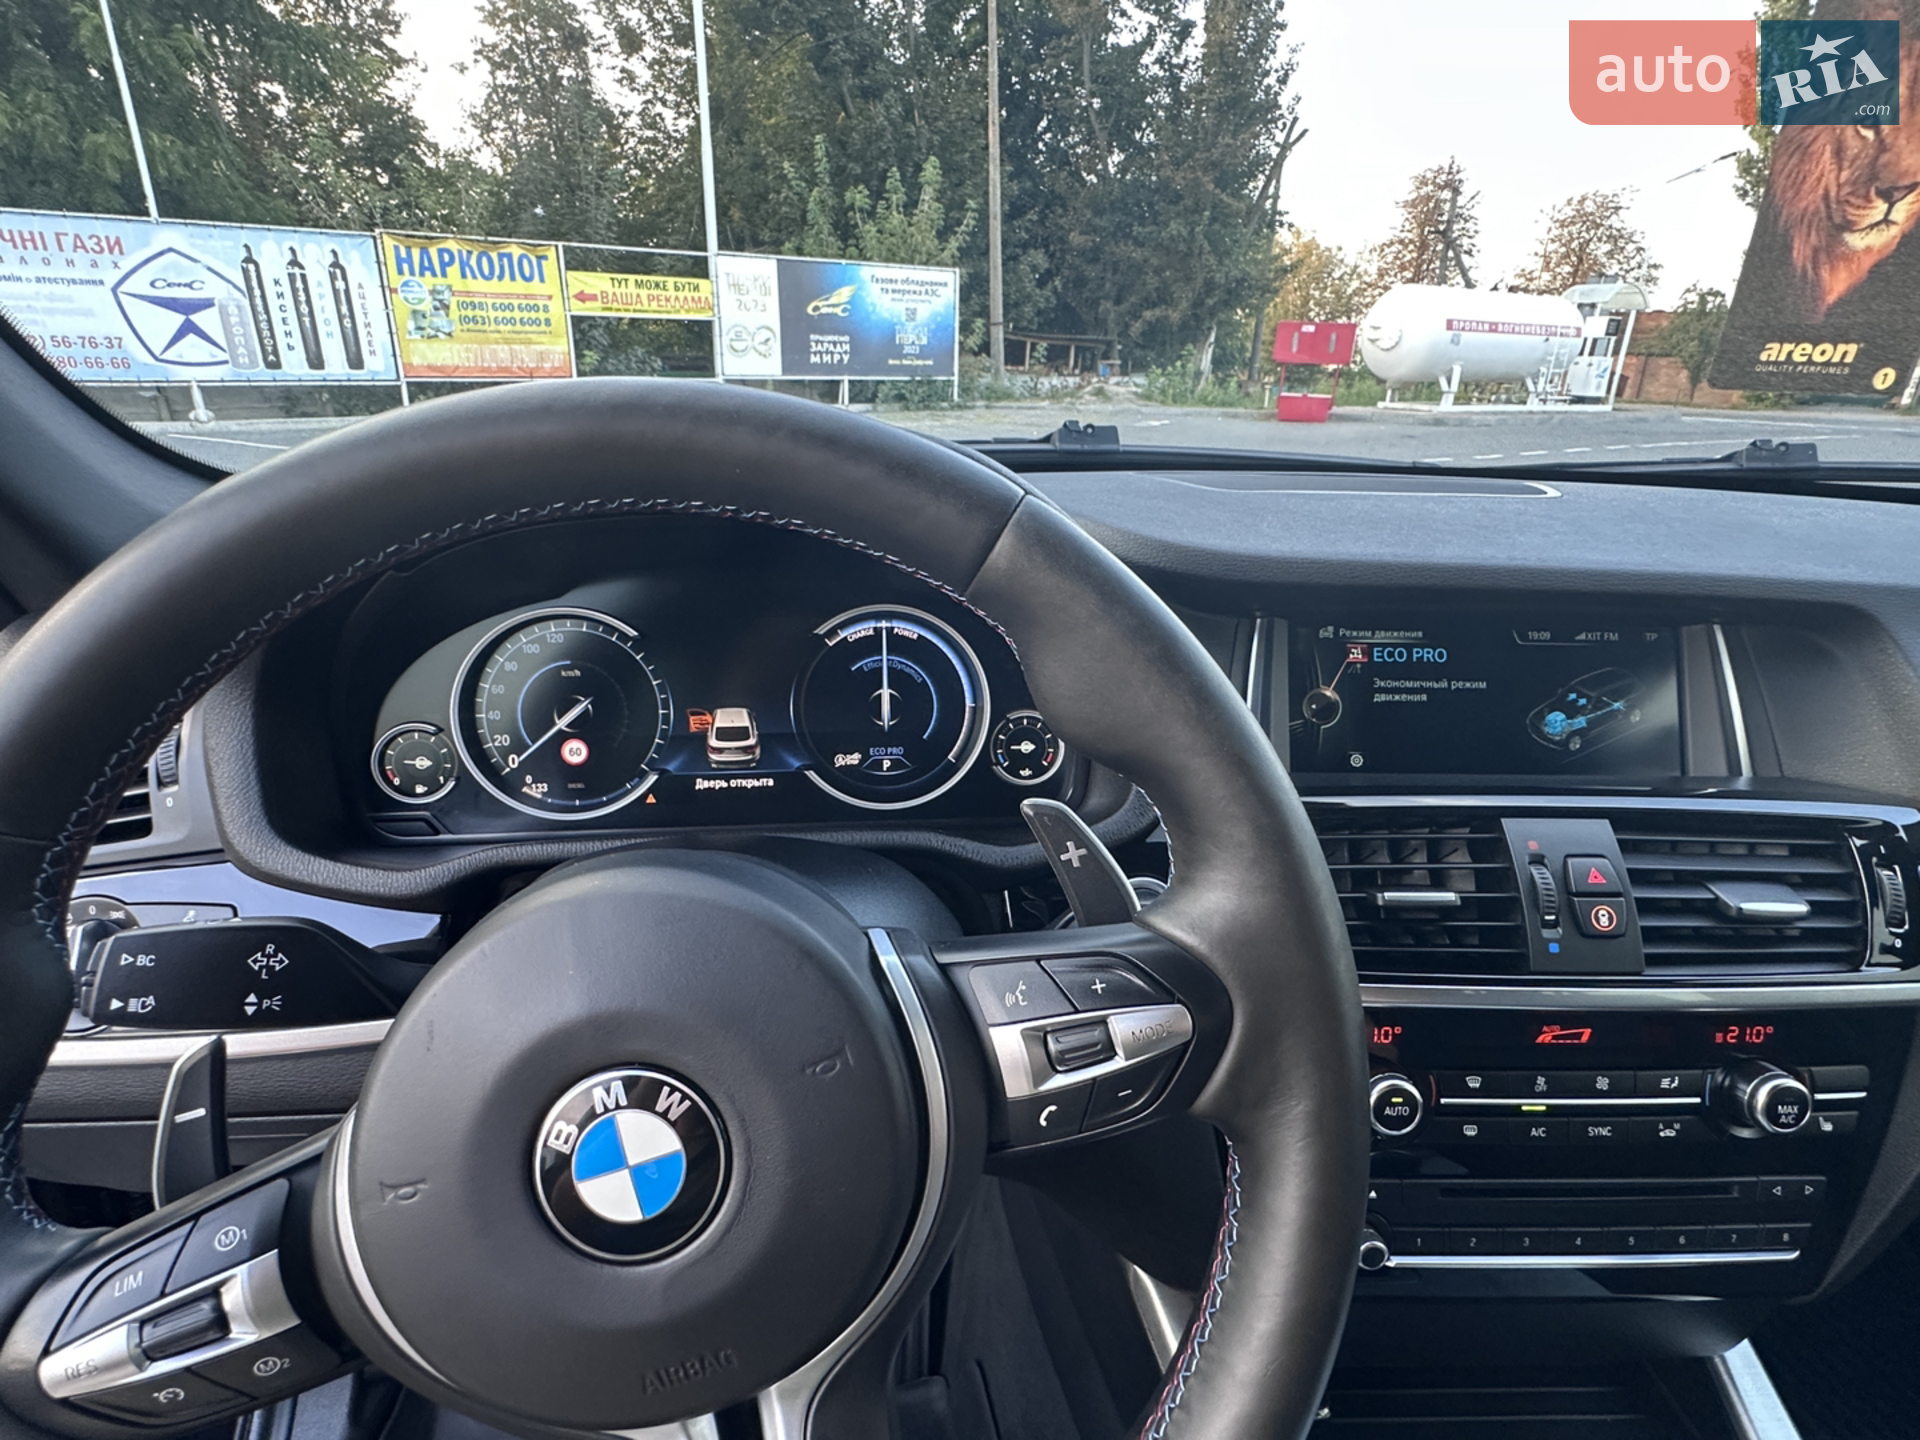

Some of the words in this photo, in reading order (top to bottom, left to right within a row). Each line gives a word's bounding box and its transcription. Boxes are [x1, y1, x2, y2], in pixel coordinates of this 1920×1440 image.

[54, 232, 125, 256] ГАЗИ
[394, 244, 549, 284] НАРКОЛОГ
[609, 277, 630, 290] ТУТ
[635, 278, 669, 292] МОЖЕ
[673, 281, 700, 293] БУТИ
[457, 300, 489, 313] (098)
[491, 302, 515, 312] 600
[517, 303, 540, 313] 600
[542, 304, 550, 313] 8
[600, 291, 644, 307] ВАША
[647, 294, 714, 312] РЕКЛАМА
[273, 278, 295, 352] КИСЕНЬ
[459, 314, 491, 327] (063)
[494, 316, 517, 326] 600
[519, 317, 542, 327] 600
[544, 318, 552, 327] 8
[1452, 321, 1490, 333] ПРОПАН
[50, 335, 124, 350] 56-76-37
[809, 341, 851, 353] ЗАРАДИ
[1760, 342, 1858, 363] areon
[809, 353, 850, 364] МИРУ
[1755, 363, 1794, 374] QUALITY
[1796, 365, 1851, 375] PERFUMES
[546, 633, 564, 643] 120
[847, 627, 875, 642] CHARGE
[893, 627, 919, 640] POWER
[1339, 628, 1372, 638] Режим
[1374, 630, 1424, 640] движения
[1528, 631, 1551, 641] 19:09
[1604, 631, 1619, 641] FM
[1645, 632, 1658, 641] TP
[522, 644, 540, 654] 100
[1373, 647, 1407, 662] ECO
[1412, 647, 1448, 662] PRO
[504, 661, 518, 671] 80
[561, 669, 581, 677] km/h
[491, 684, 505, 694] 60
[1373, 677, 1448, 689] Экономичный
[1451, 679, 1487, 690] режим
[1373, 693, 1427, 703] движения
[487, 710, 501, 720] 40
[493, 734, 510, 746] 20
[568, 747, 582, 757] 60
[869, 747, 886, 756] ECO
[887, 746, 904, 756] PRO
[508, 754, 519, 768] 0
[882, 760, 892, 771] P
[525, 774, 533, 784] 0
[695, 778, 728, 790] Дверь
[729, 778, 774, 789] открыта
[265, 944, 275, 955] R
[136, 954, 156, 967] BC
[261, 968, 269, 979] L
[262, 998, 271, 1010] P
[1131, 1021, 1174, 1044] MODE
[1383, 1106, 1410, 1117] AUTO
[1777, 1105, 1799, 1114] MAX
[546, 1079, 692, 1155] BMW
[1780, 1115, 1796, 1124] A/C
[1530, 1127, 1547, 1137] A/C
[1588, 1126, 1612, 1137] SYNC
[1417, 1237, 1422, 1246] 1
[1469, 1238, 1477, 1247] 2
[1523, 1237, 1530, 1247] 3
[1575, 1237, 1582, 1246] 4
[1628, 1236, 1635, 1246] 5
[1678, 1235, 1686, 1245] 6
[1731, 1234, 1737, 1243] 7
[1782, 1233, 1789, 1242] 8
[114, 1271, 144, 1297] LIM
[64, 1358, 99, 1381] RES
[641, 1349, 740, 1395] AIRBAG
